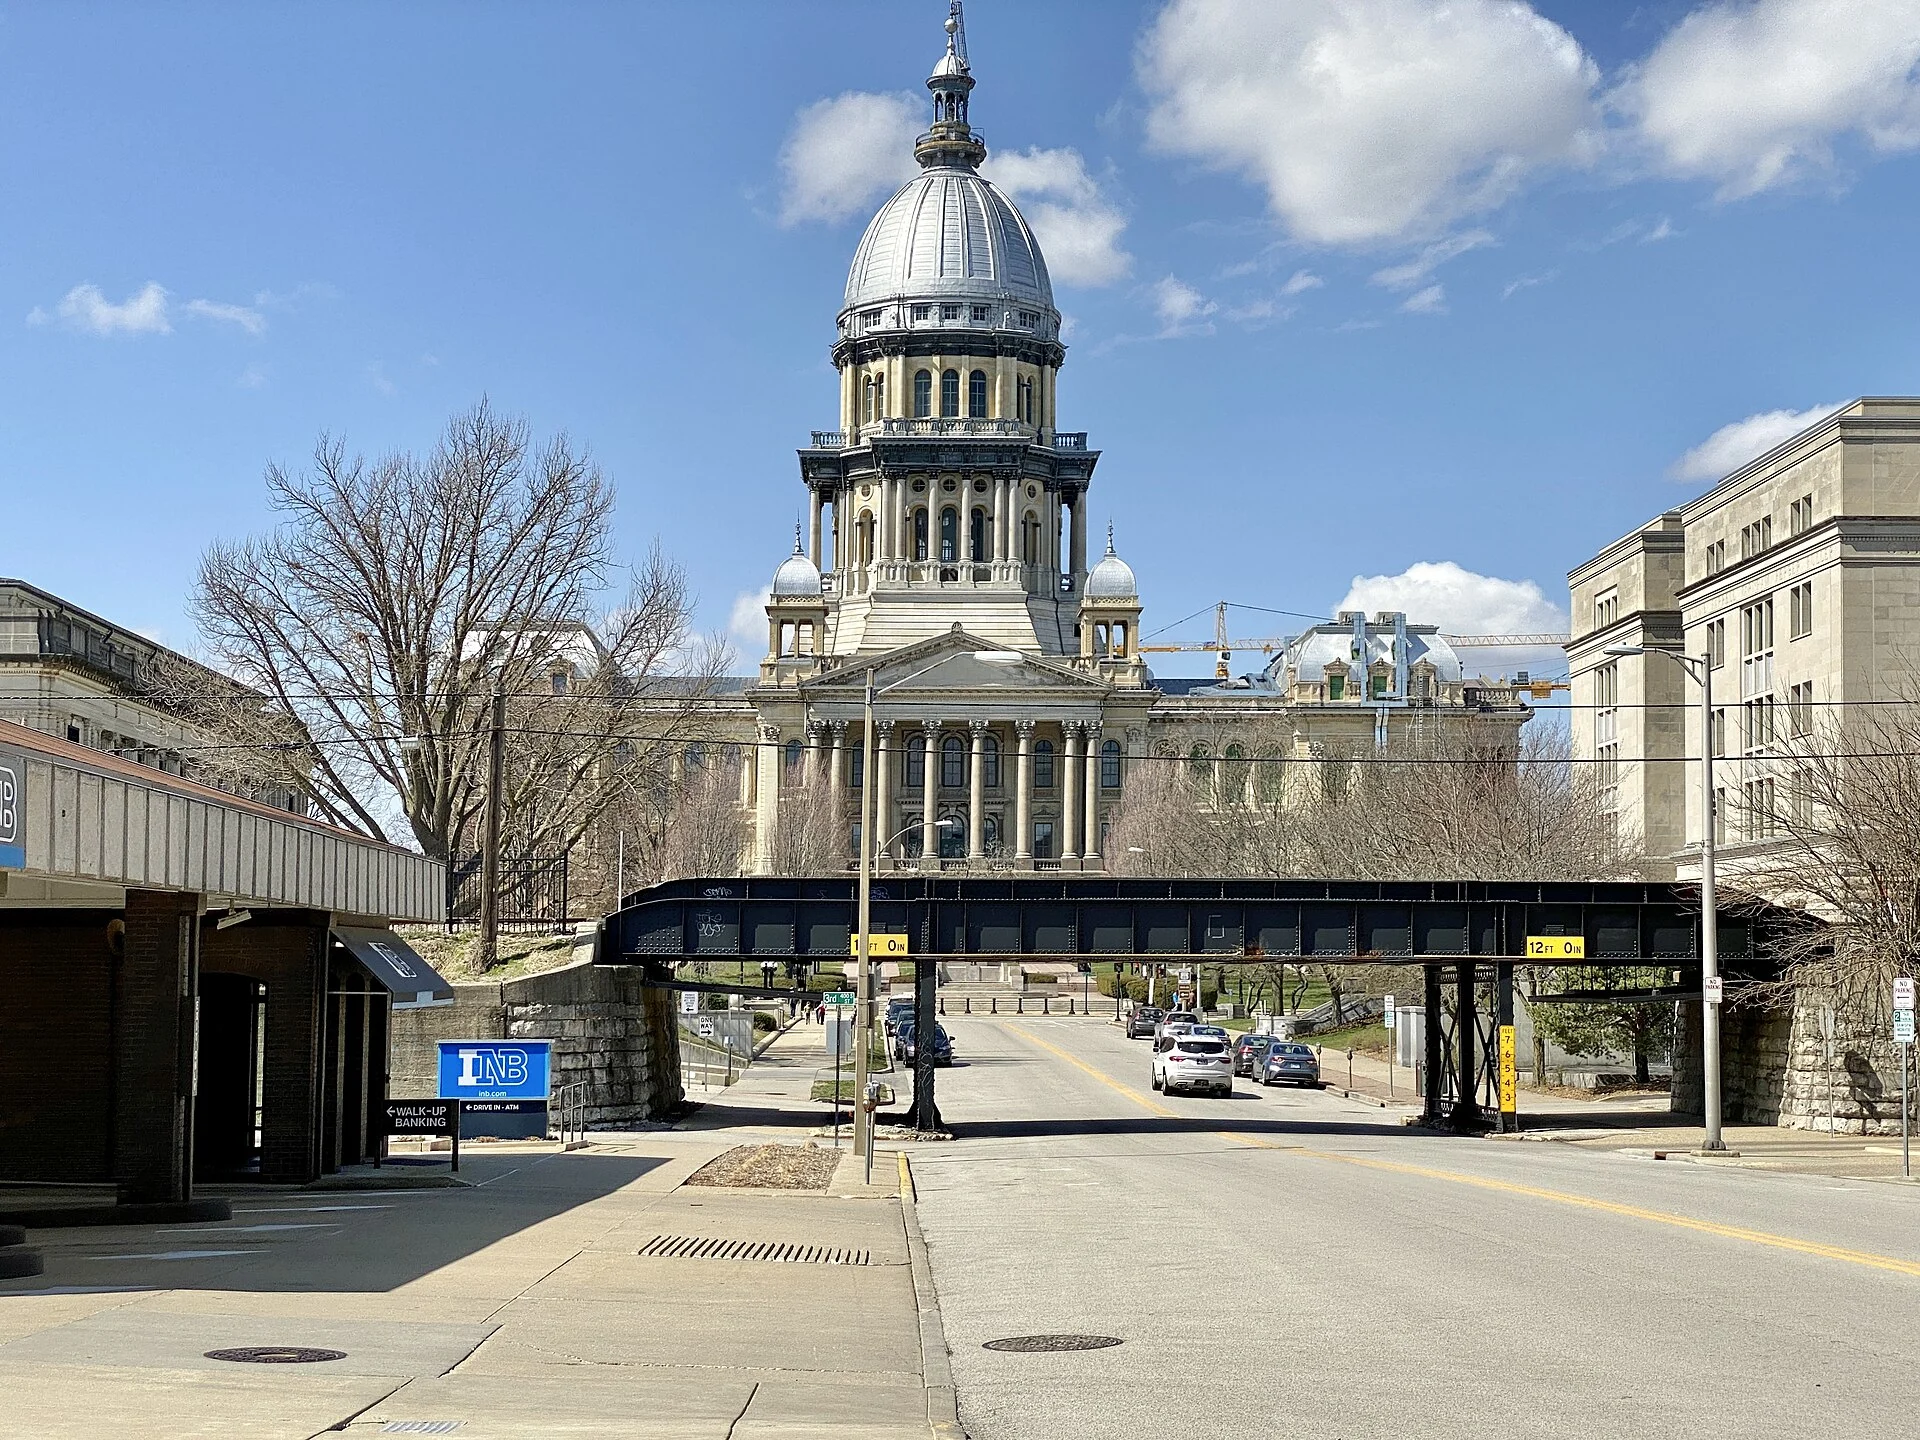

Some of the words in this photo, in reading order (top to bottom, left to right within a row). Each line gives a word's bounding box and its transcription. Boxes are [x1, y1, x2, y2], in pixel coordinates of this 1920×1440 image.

[825, 993, 837, 1004] 3rd
[1505, 1050, 1511, 1058] 6
[458, 1048, 528, 1086] INB
[1505, 1064, 1511, 1072] 5
[1504, 1079, 1511, 1087] 4
[1505, 1094, 1511, 1102] 3
[396, 1106, 447, 1116] WALK-UP
[395, 1117, 446, 1127] BANKING
